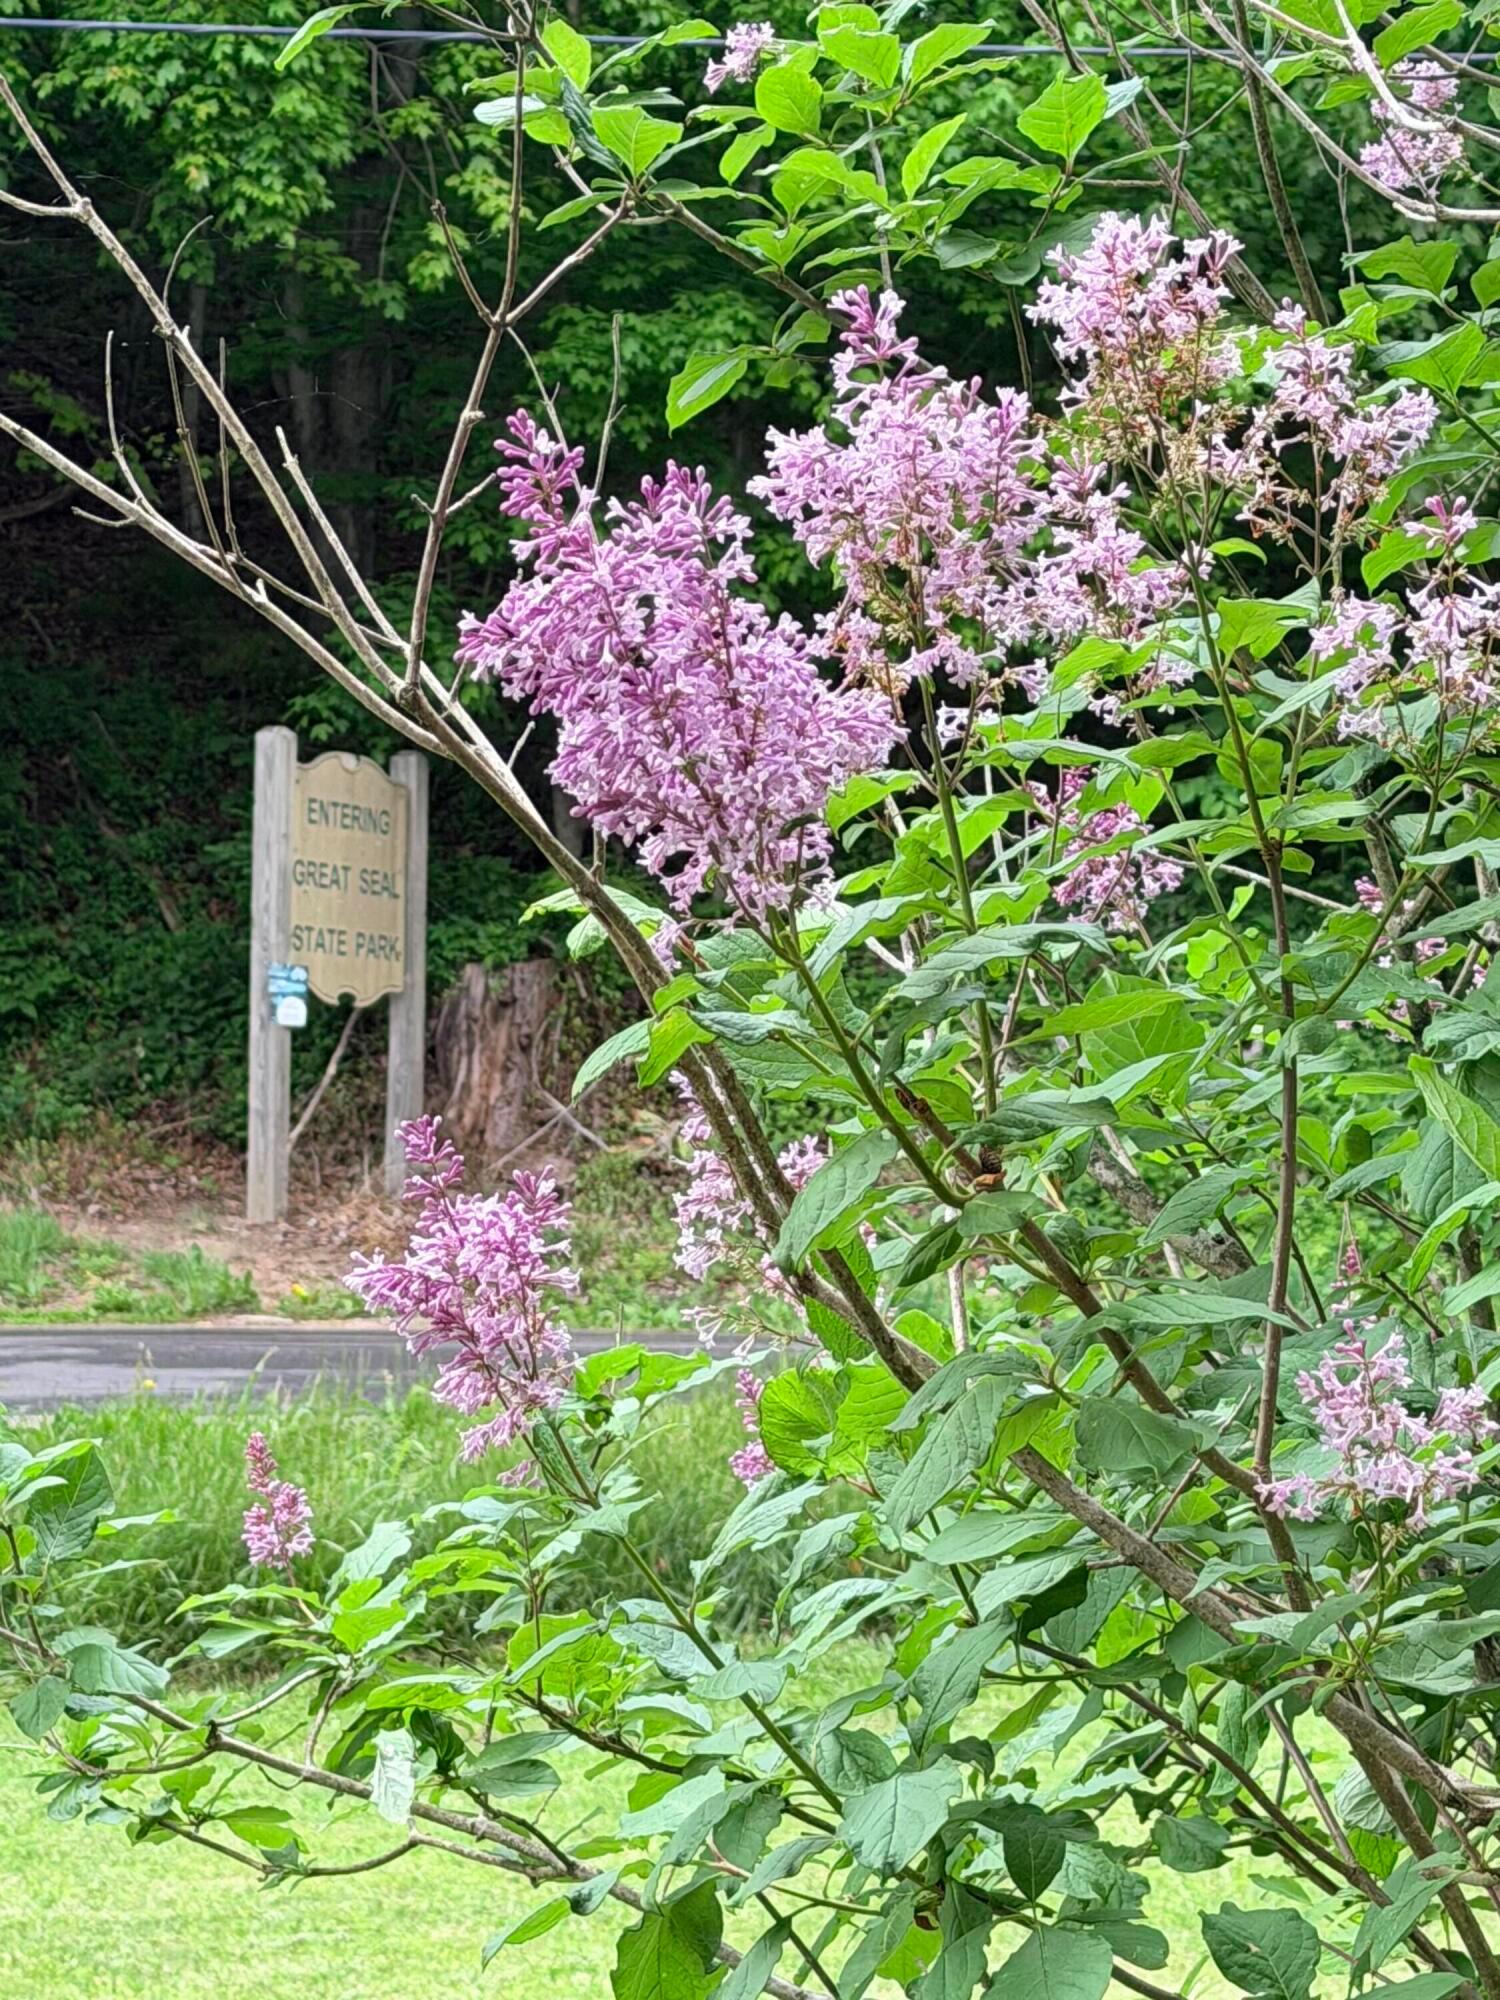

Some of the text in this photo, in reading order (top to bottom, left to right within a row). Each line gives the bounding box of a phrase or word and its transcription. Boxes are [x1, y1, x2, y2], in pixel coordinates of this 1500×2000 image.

[307, 798, 390, 835] ENTERING
[293, 859, 400, 899] GREAT SEAL
[292, 924, 401, 961] STATE PARK
